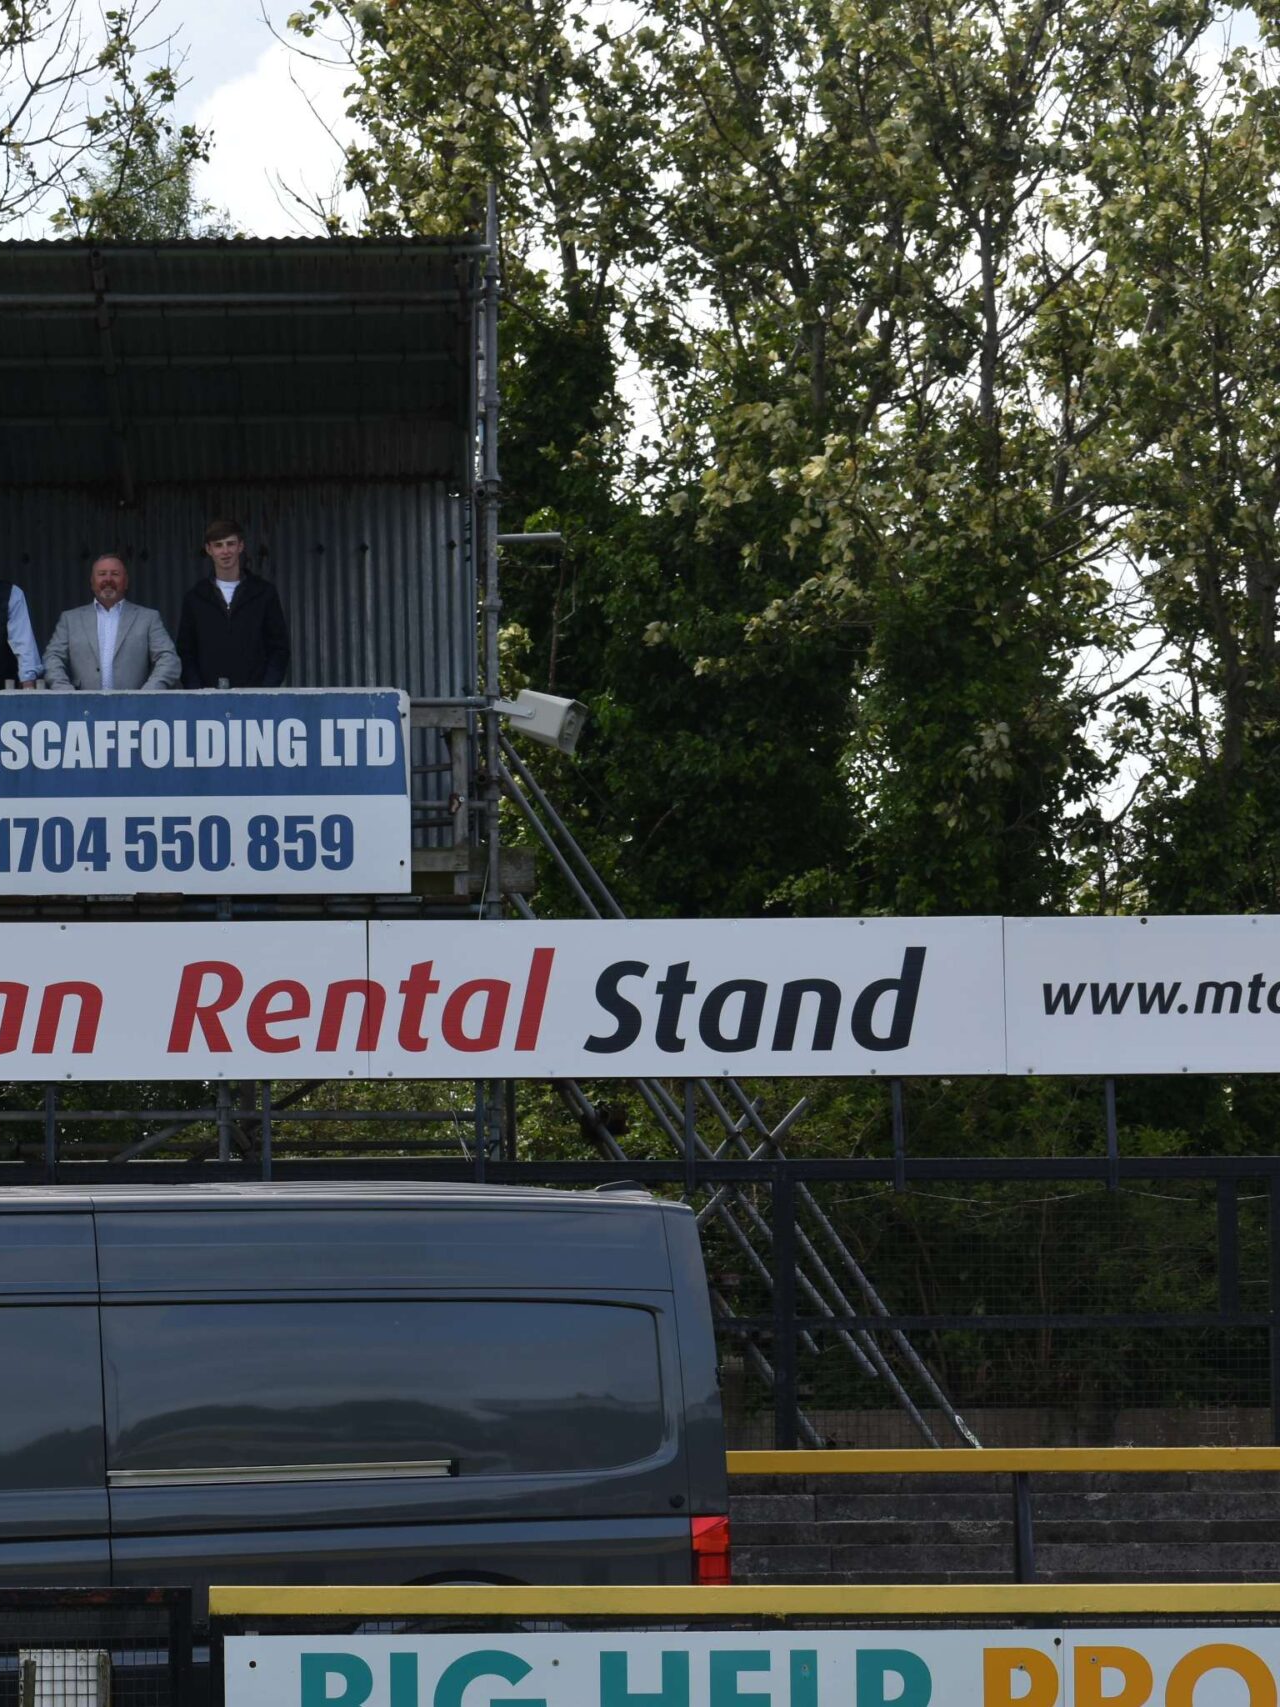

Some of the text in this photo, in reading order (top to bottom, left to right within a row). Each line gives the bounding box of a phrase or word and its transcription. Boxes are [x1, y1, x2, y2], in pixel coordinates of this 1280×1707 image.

[0, 718, 308, 770] SCAFFOLDING
[320, 717, 397, 767] LTD
[123, 814, 232, 873] 550
[246, 813, 354, 873] 859
[168, 948, 556, 1053] Rental
[583, 946, 927, 1054] Stand
